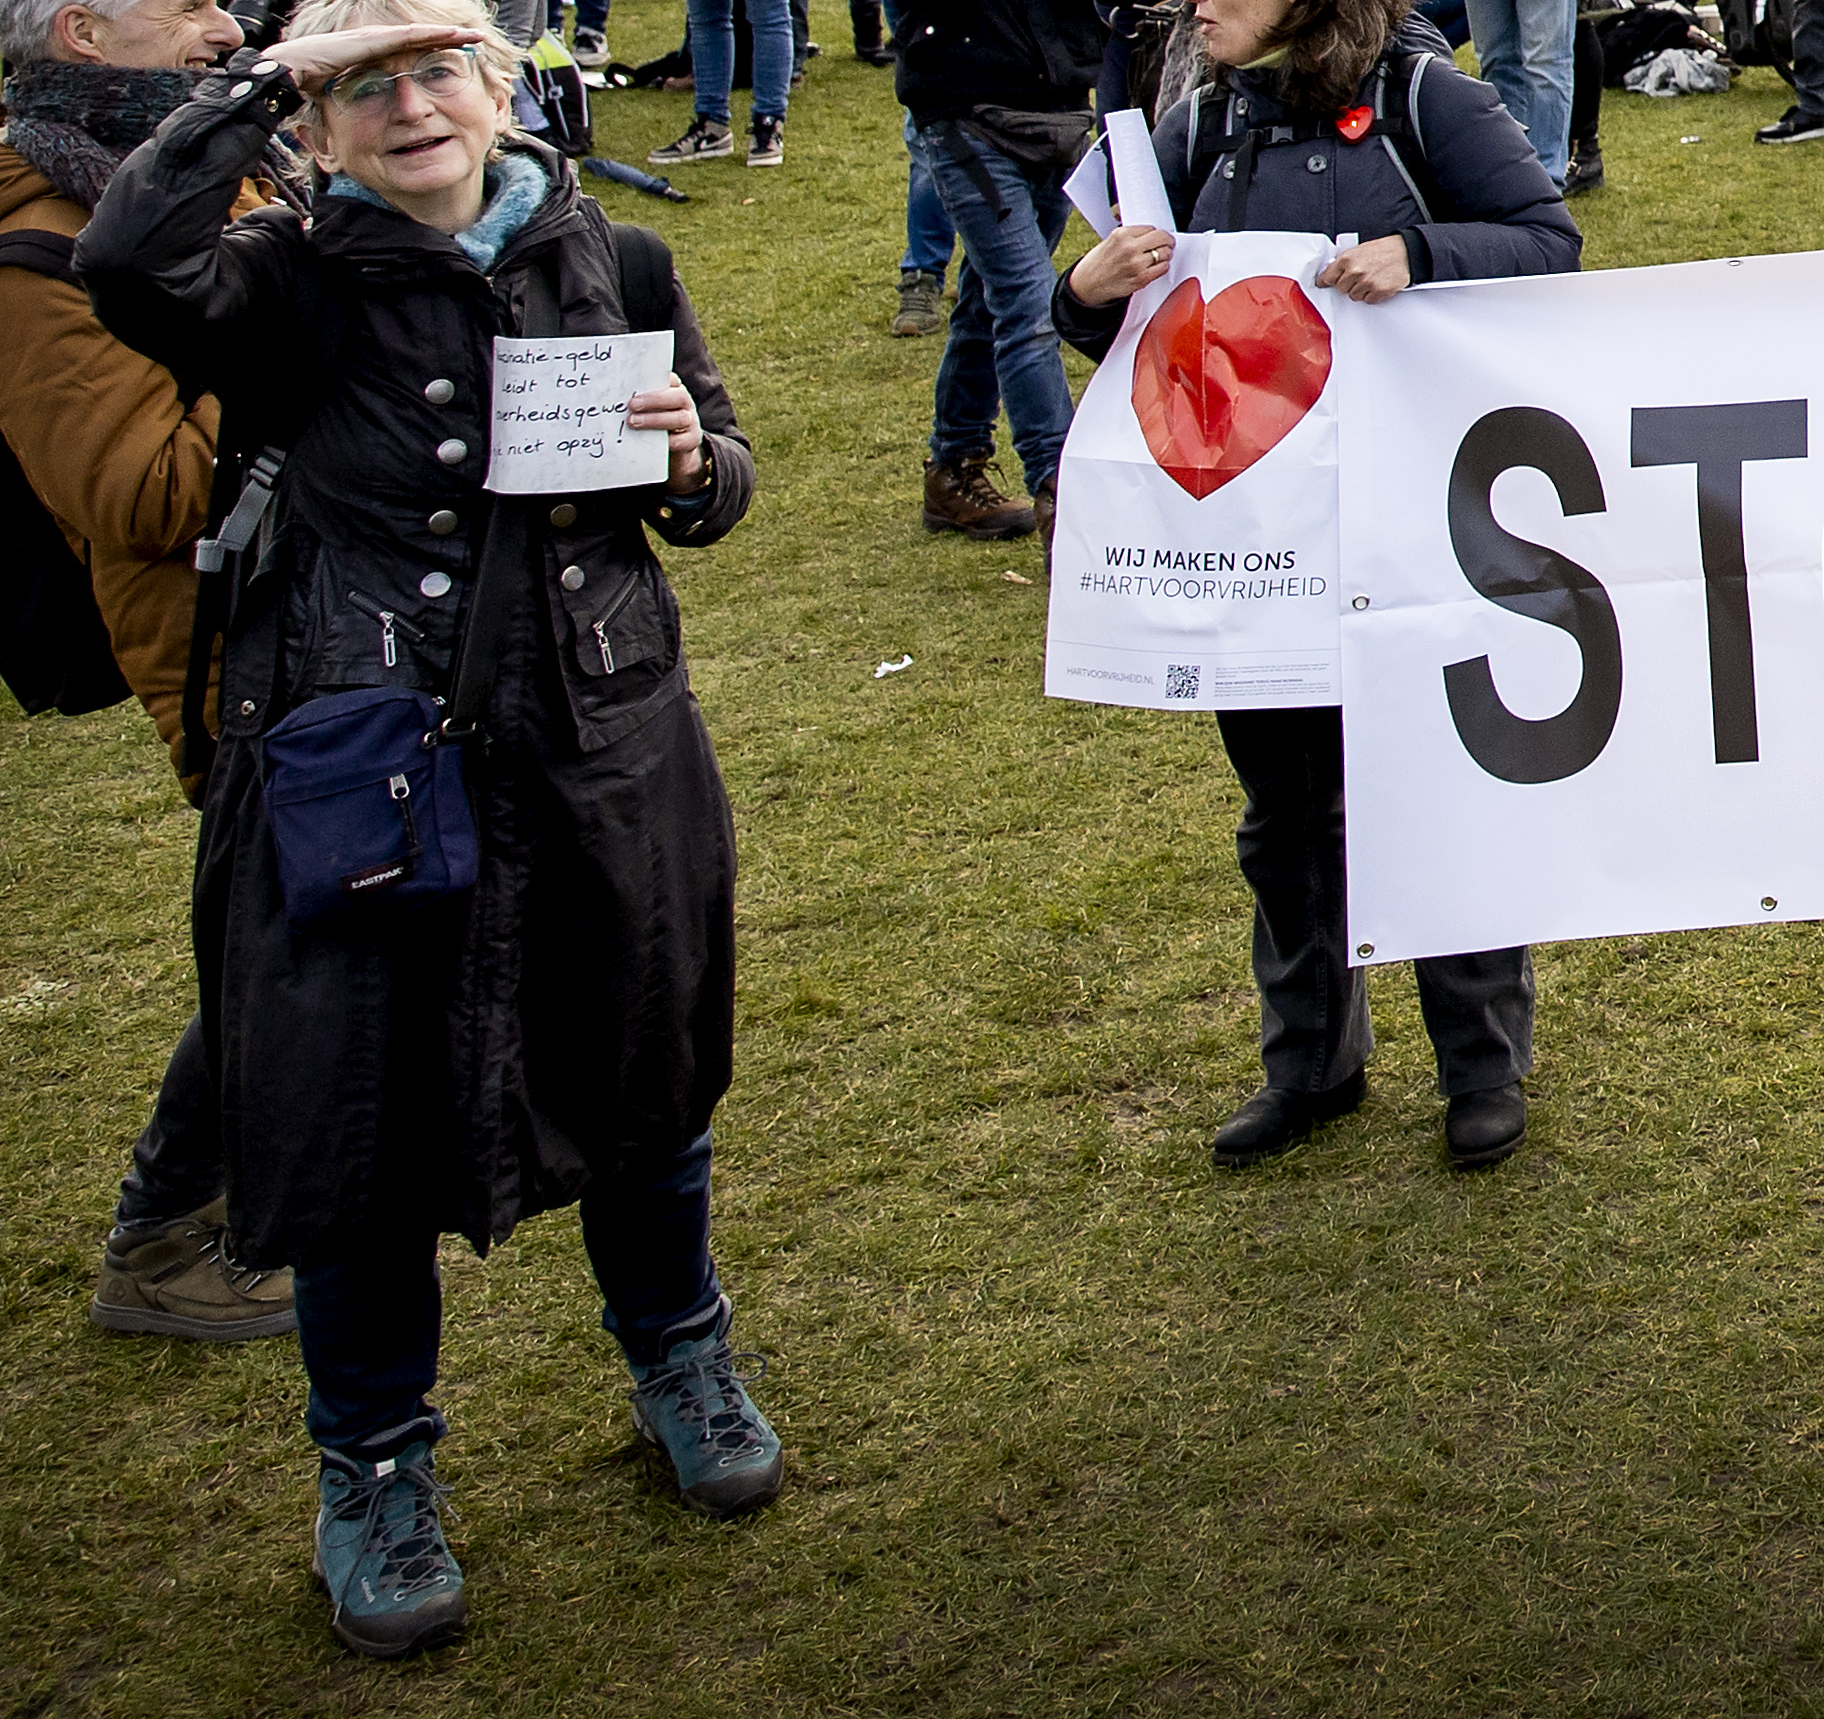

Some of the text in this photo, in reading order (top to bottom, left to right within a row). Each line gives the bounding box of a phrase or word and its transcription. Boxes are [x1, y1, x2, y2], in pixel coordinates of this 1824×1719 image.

[556, 372, 590, 388] tot
[507, 438, 544, 455] niet
[1105, 546, 1296, 572] WIJ MAKEN ONS
[1080, 572, 1327, 600] #HARTVOORVRIJHEID
[1066, 667, 1154, 685] HARTVOORVRIJHEID.NL
[351, 866, 404, 889] EASTPAK
